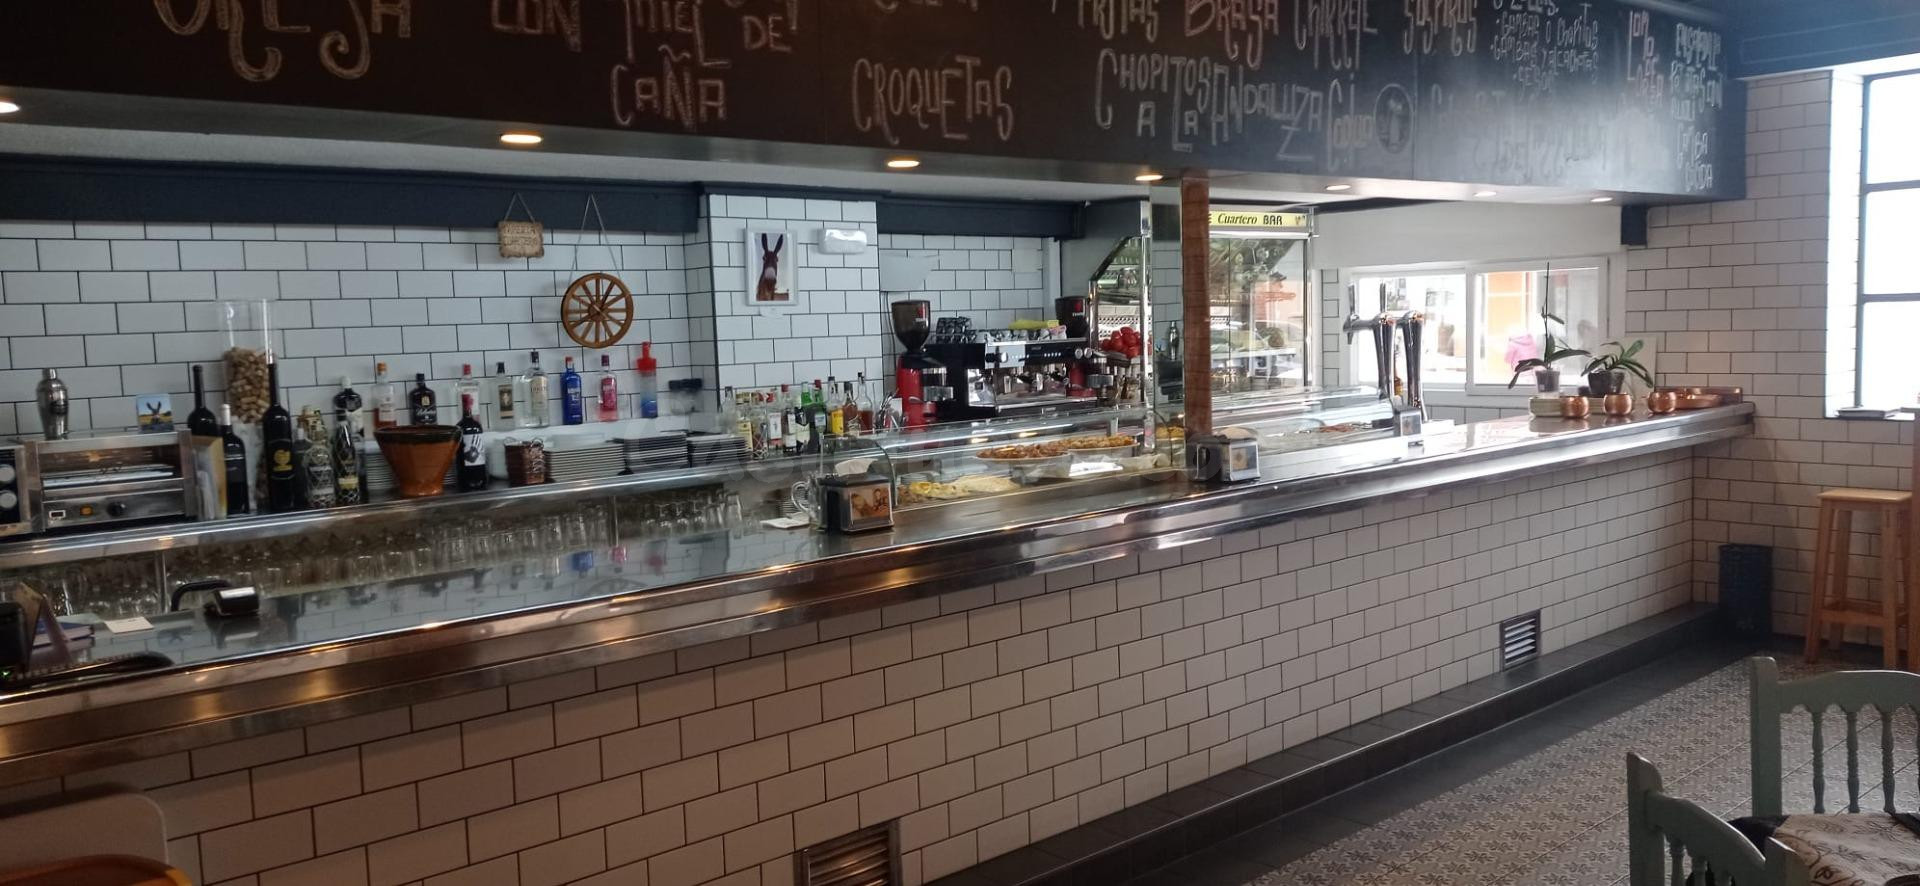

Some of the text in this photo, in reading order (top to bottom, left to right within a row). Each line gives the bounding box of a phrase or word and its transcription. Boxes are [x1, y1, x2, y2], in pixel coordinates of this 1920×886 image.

[741, 15, 793, 54] DE
[611, 44, 728, 132] CAÑA
[851, 55, 1014, 146] CROQUETAS
[1095, 47, 1212, 129] CHOPITOS
[1136, 101, 1156, 137] A
[1217, 213, 1258, 225] Cuartero
[1263, 214, 1283, 226] BAR
